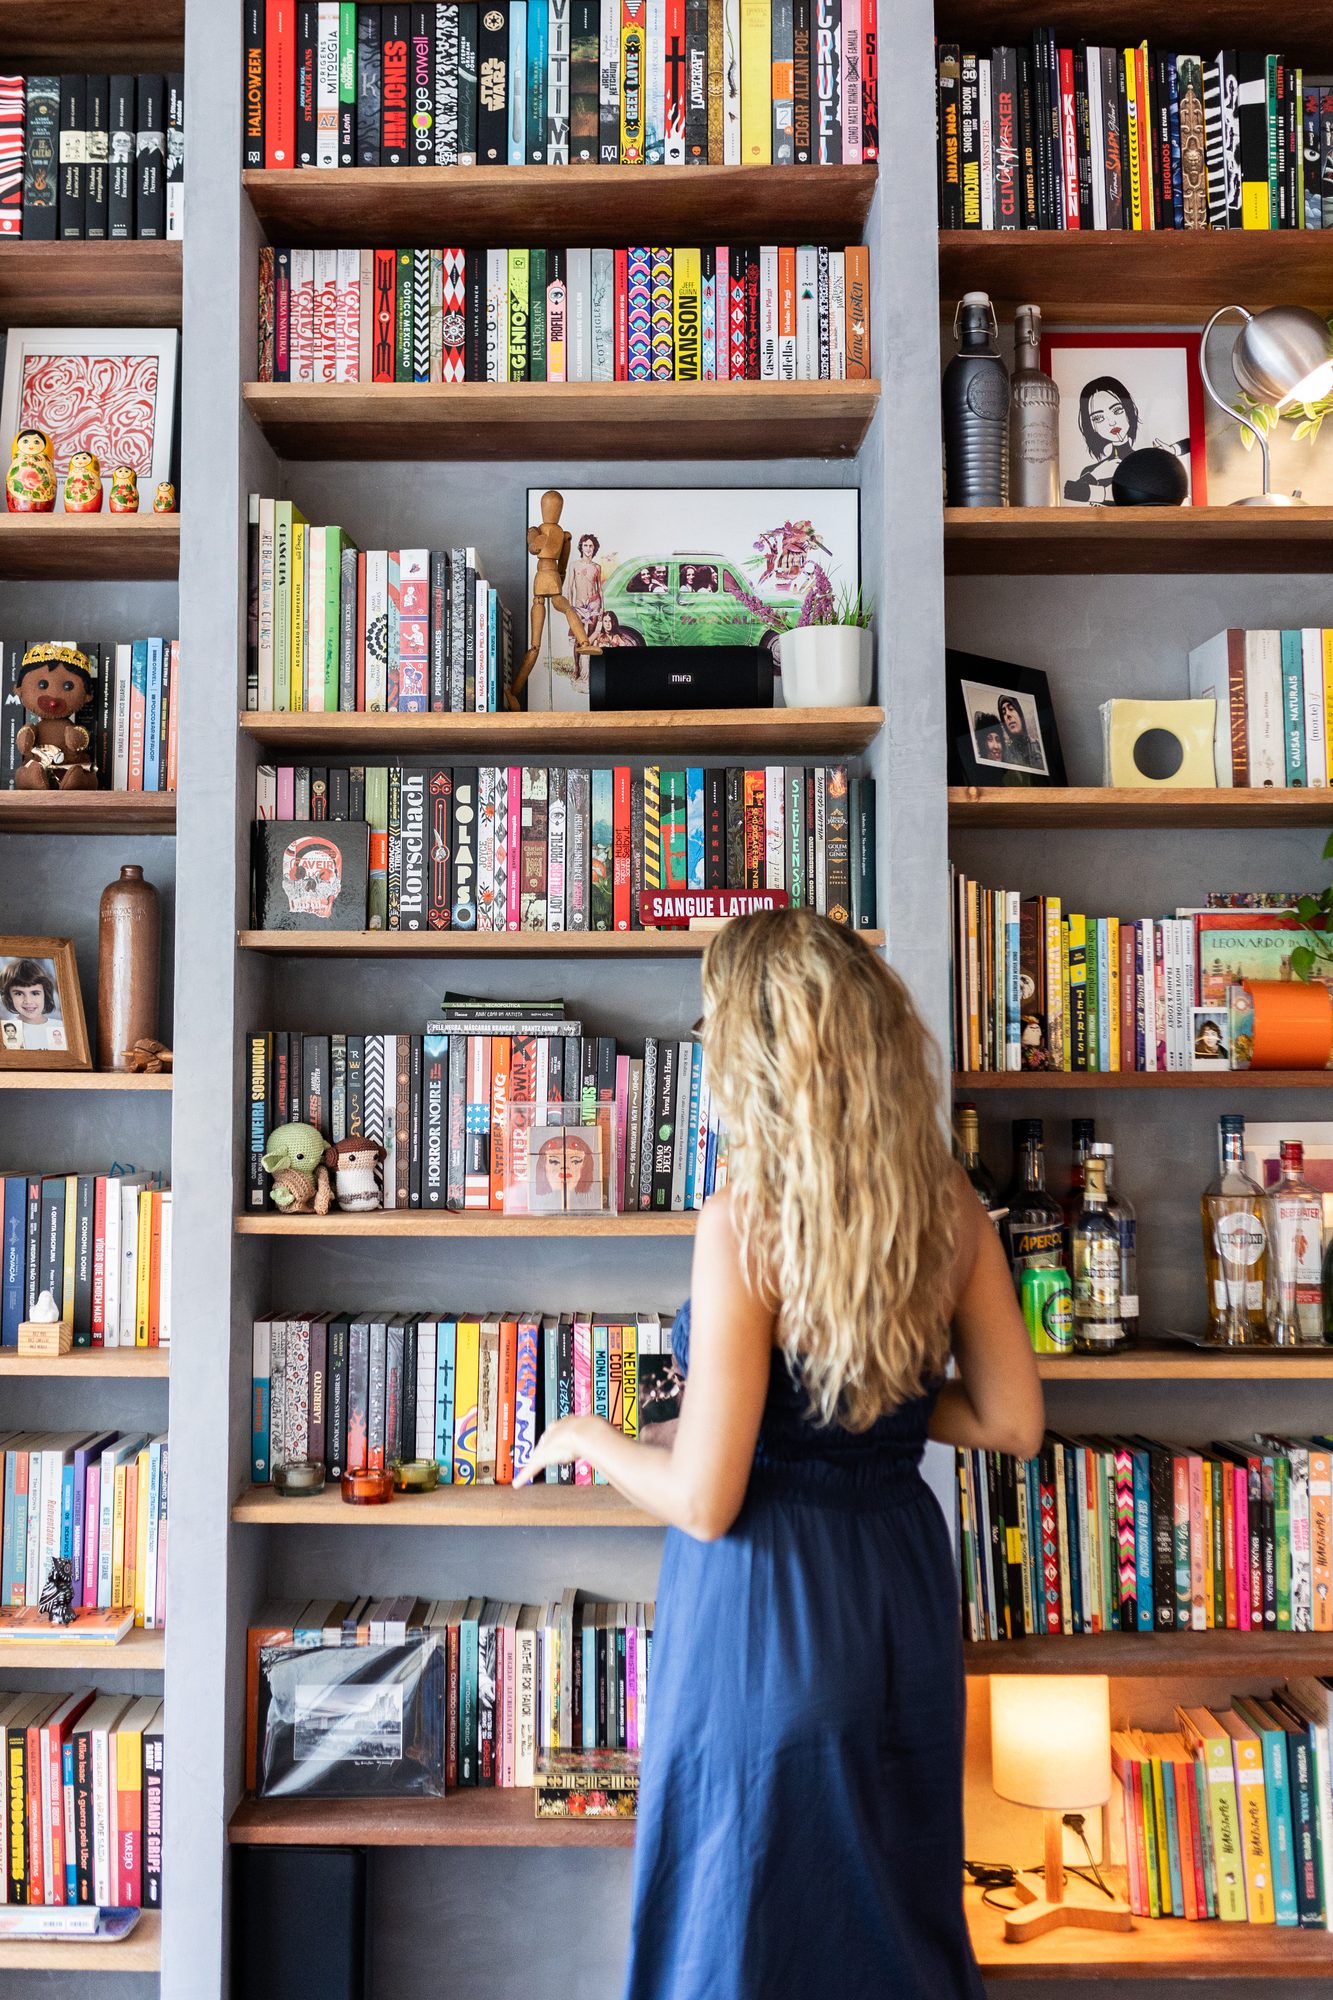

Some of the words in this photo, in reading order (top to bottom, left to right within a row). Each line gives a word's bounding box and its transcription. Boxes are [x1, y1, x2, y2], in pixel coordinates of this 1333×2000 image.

[328, 30, 338, 94] MITOLOGIA
[413, 36, 428, 85] orwell
[795, 30, 808, 55] POE
[346, 48, 354, 89] Rosemary
[385, 40, 407, 108] JONES
[480, 58, 496, 104] STAR
[488, 60, 506, 111] WARS
[609, 62, 618, 96] KETCHUM
[626, 46, 639, 86] LOVE
[692, 49, 705, 110] LOVECRAFT
[795, 60, 808, 100] ALLAN
[248, 47, 262, 138] HALLOWEEN
[626, 92, 639, 121] GEEK
[962, 86, 972, 115] MOORE
[385, 110, 407, 149] JIM
[795, 106, 808, 147] EDGAR
[850, 106, 858, 124] MATEI
[946, 103, 956, 135] TOM
[850, 126, 858, 144] COMO
[963, 118, 973, 153] GIBBONS
[982, 120, 990, 172] MONSTERS
[1106, 130, 1121, 171] SALEM
[946, 137, 958, 184] SAVINI
[1064, 94, 1078, 217] KARMEN
[1163, 143, 1172, 200] REFUGIADOS
[964, 162, 980, 223] WATCHMEN
[280, 291, 288, 316] BRUXA
[404, 281, 412, 318] GÓTICO
[594, 300, 604, 334] SIGLER
[784, 289, 792, 306] Pileggi
[847, 281, 864, 328] Austen
[279, 318, 287, 356] NATURAL
[512, 302, 527, 368] GÊNIOS
[534, 300, 543, 342] TOLKIEN
[552, 310, 562, 342] PROFILE
[679, 296, 698, 381] MANSON
[403, 319, 411, 368] MEXICANO
[763, 339, 774, 377] Cassino
[1290, 675, 1299, 722] NATURAIS
[1230, 669, 1248, 772] HANNIBAL
[132, 711, 142, 776] OUTUBRO
[1292, 730, 1300, 768] CAUSAS
[401, 775, 424, 912] Rorschach
[479, 841, 488, 868] JOYCE
[792, 779, 800, 909] STEVENSON
[653, 896, 714, 917] SANGUE
[720, 896, 774, 914] LATINO
[1212, 938, 1284, 948] LEONARDO
[432, 1024, 443, 1032] PELE
[443, 1024, 462, 1033] NEGRA,
[464, 1022, 491, 1032] MÁSCARAS
[492, 1024, 516, 1032] BRANCAS
[522, 1024, 540, 1032] FRANTZ
[542, 1024, 559, 1032] FANON
[1076, 990, 1086, 1052] TETRIS
[252, 1038, 265, 1100] DOMINGOS
[664, 1049, 672, 1074] Harari
[428, 1080, 441, 1124] NOIRE
[492, 1072, 507, 1130] KING
[662, 1074, 671, 1095] Noah
[692, 1087, 698, 1100] DE
[662, 1096, 670, 1116] Yuval
[252, 1102, 264, 1153] OLIVEIRA
[428, 1125, 441, 1187] HORROR
[494, 1123, 504, 1176] STEPHEN
[513, 1128, 528, 1182] KILLER
[663, 1145, 672, 1174] DEUS
[1279, 1207, 1320, 1220] BEEFEATER
[95, 1238, 104, 1261] VÍDEOS
[95, 1262, 103, 1276] QUE
[94, 1276, 103, 1305] VENDEM
[94, 1306, 102, 1323] MAIS
[596, 1350, 606, 1378] MONA
[313, 1371, 322, 1424] LABIRINTO
[597, 1380, 606, 1402] LISA
[332, 1420, 340, 1452] CRÔNICAS
[16, 1505, 26, 1573] STORYTELLING
[46, 1500, 56, 1546] Reinventando
[1316, 1511, 1327, 1567] HEARTSTOPPER
[1252, 1537, 1260, 1568] BRUXA
[1266, 1575, 1274, 1601] BRUXA
[522, 1640, 532, 1676] MATE-ME
[146, 1744, 154, 1770] BARRY
[148, 1776, 160, 1785] A
[10, 1748, 24, 1881] MASTODONTES
[79, 1798, 88, 1828] guerra
[148, 1787, 160, 1836] GRANDE
[1221, 1798, 1233, 1855] HEARTSTOPPER
[1252, 1800, 1264, 1856] HEARTSTOPPER
[80, 1828, 88, 1847] pela
[124, 1832, 133, 1870] VAREJO
[148, 1837, 160, 1873] GRIPE
[80, 1848, 88, 1870] Uber
